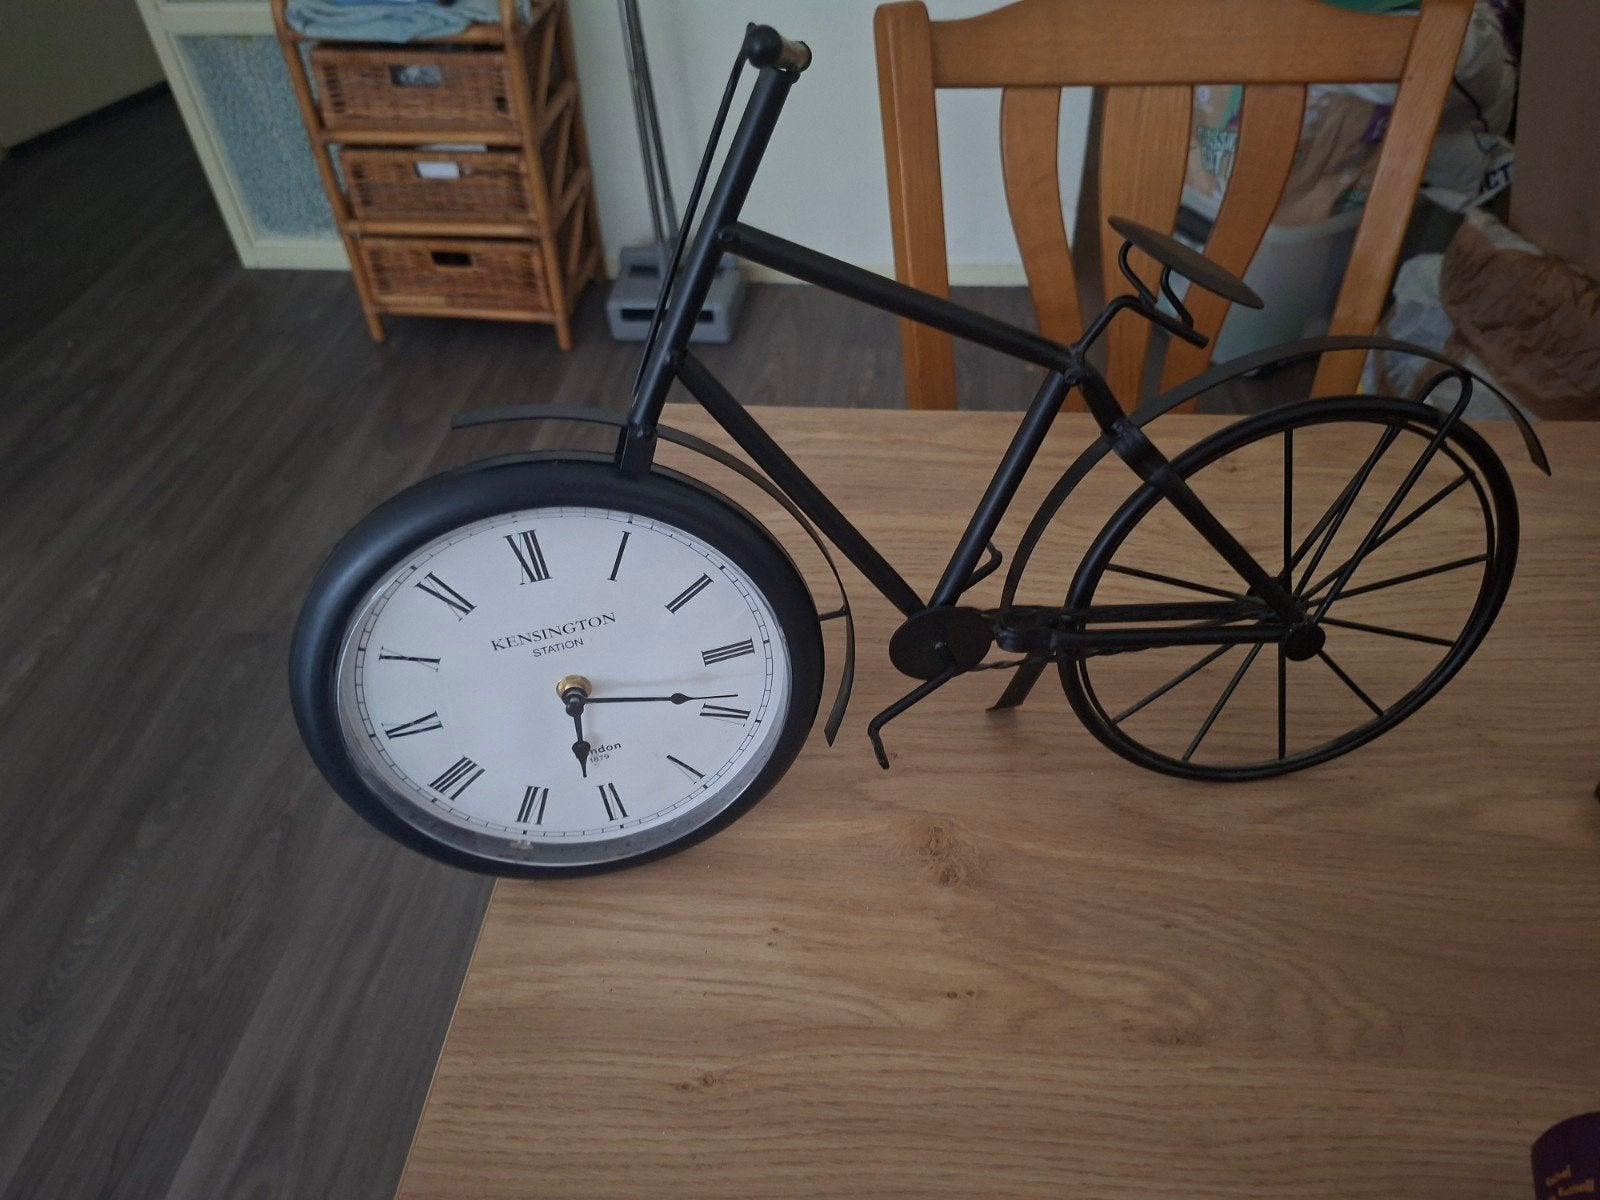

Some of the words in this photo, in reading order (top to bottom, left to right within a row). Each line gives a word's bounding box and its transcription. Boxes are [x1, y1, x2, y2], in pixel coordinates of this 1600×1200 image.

[503, 529, 553, 585] XII
[607, 531, 632, 582] I
[414, 571, 477, 622] XI
[664, 573, 714, 615] II
[491, 612, 617, 651] KENSINGTON
[532, 637, 584, 658] STATION
[378, 646, 441, 672] X
[701, 638, 755, 667] III
[381, 709, 444, 740] IX
[700, 703, 752, 727] IV
[589, 742, 622, 756] ndon
[427, 755, 486, 801] VIII
[666, 754, 706, 785] V
[516, 786, 549, 825] VII
[596, 782, 630, 821] VI
